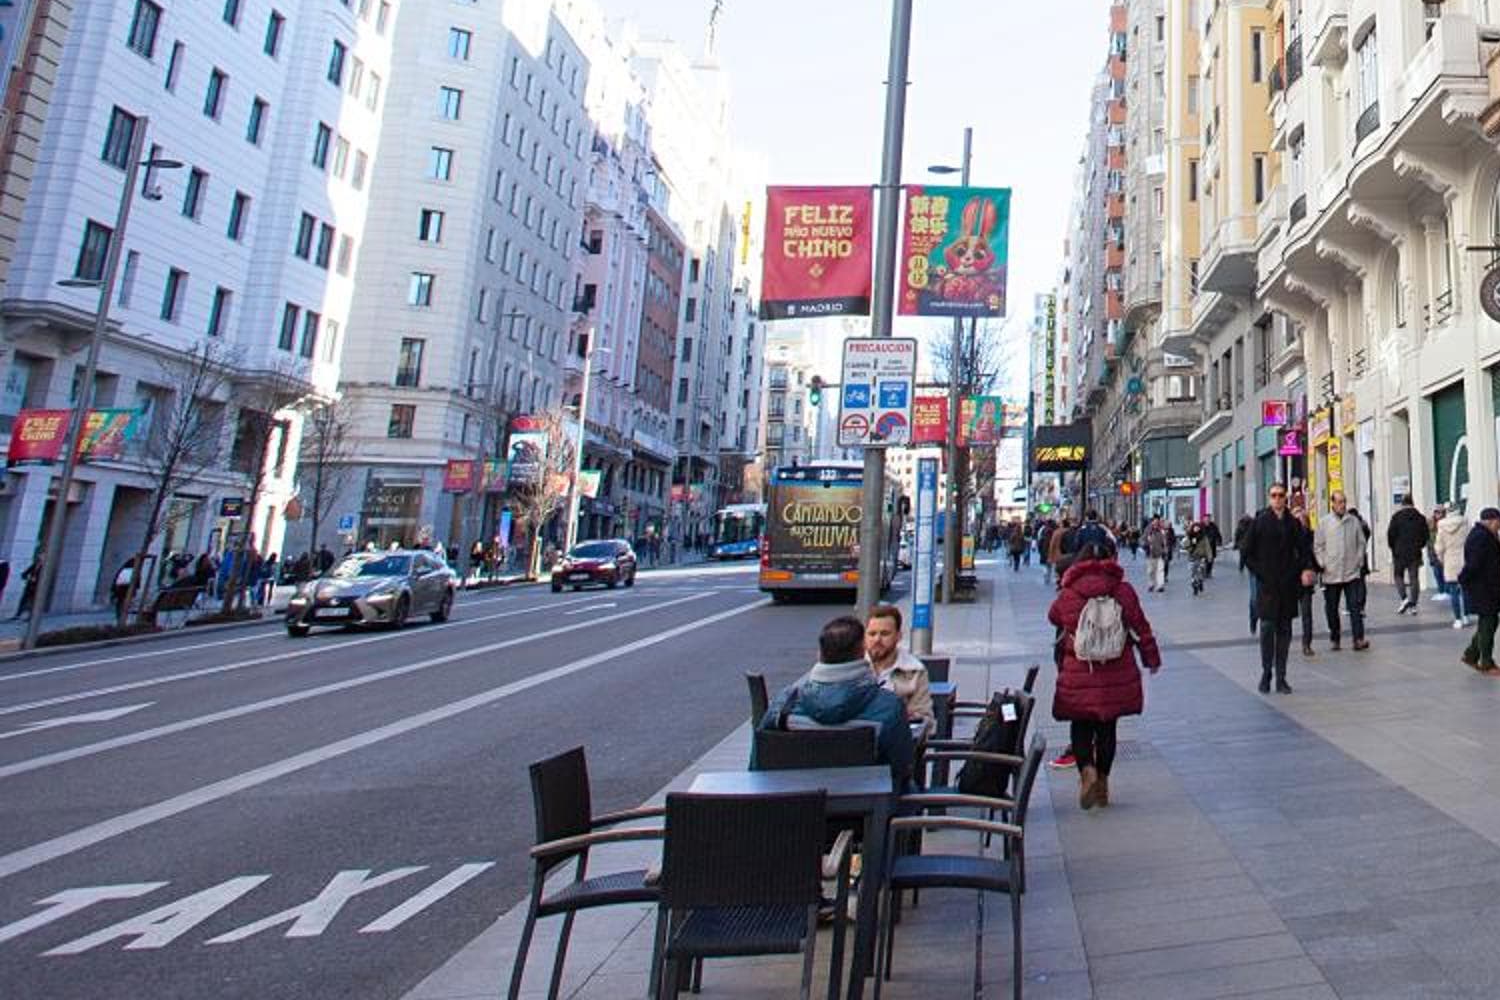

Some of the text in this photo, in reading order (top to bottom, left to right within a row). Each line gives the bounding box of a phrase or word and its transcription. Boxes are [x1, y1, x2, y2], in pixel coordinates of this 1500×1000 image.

[784, 205, 853, 225] FELIZ
[811, 226, 853, 237] NUEVO
[783, 239, 853, 258] CHINO
[800, 303, 844, 313] MADRID
[0, 861, 497, 956] TAXI
